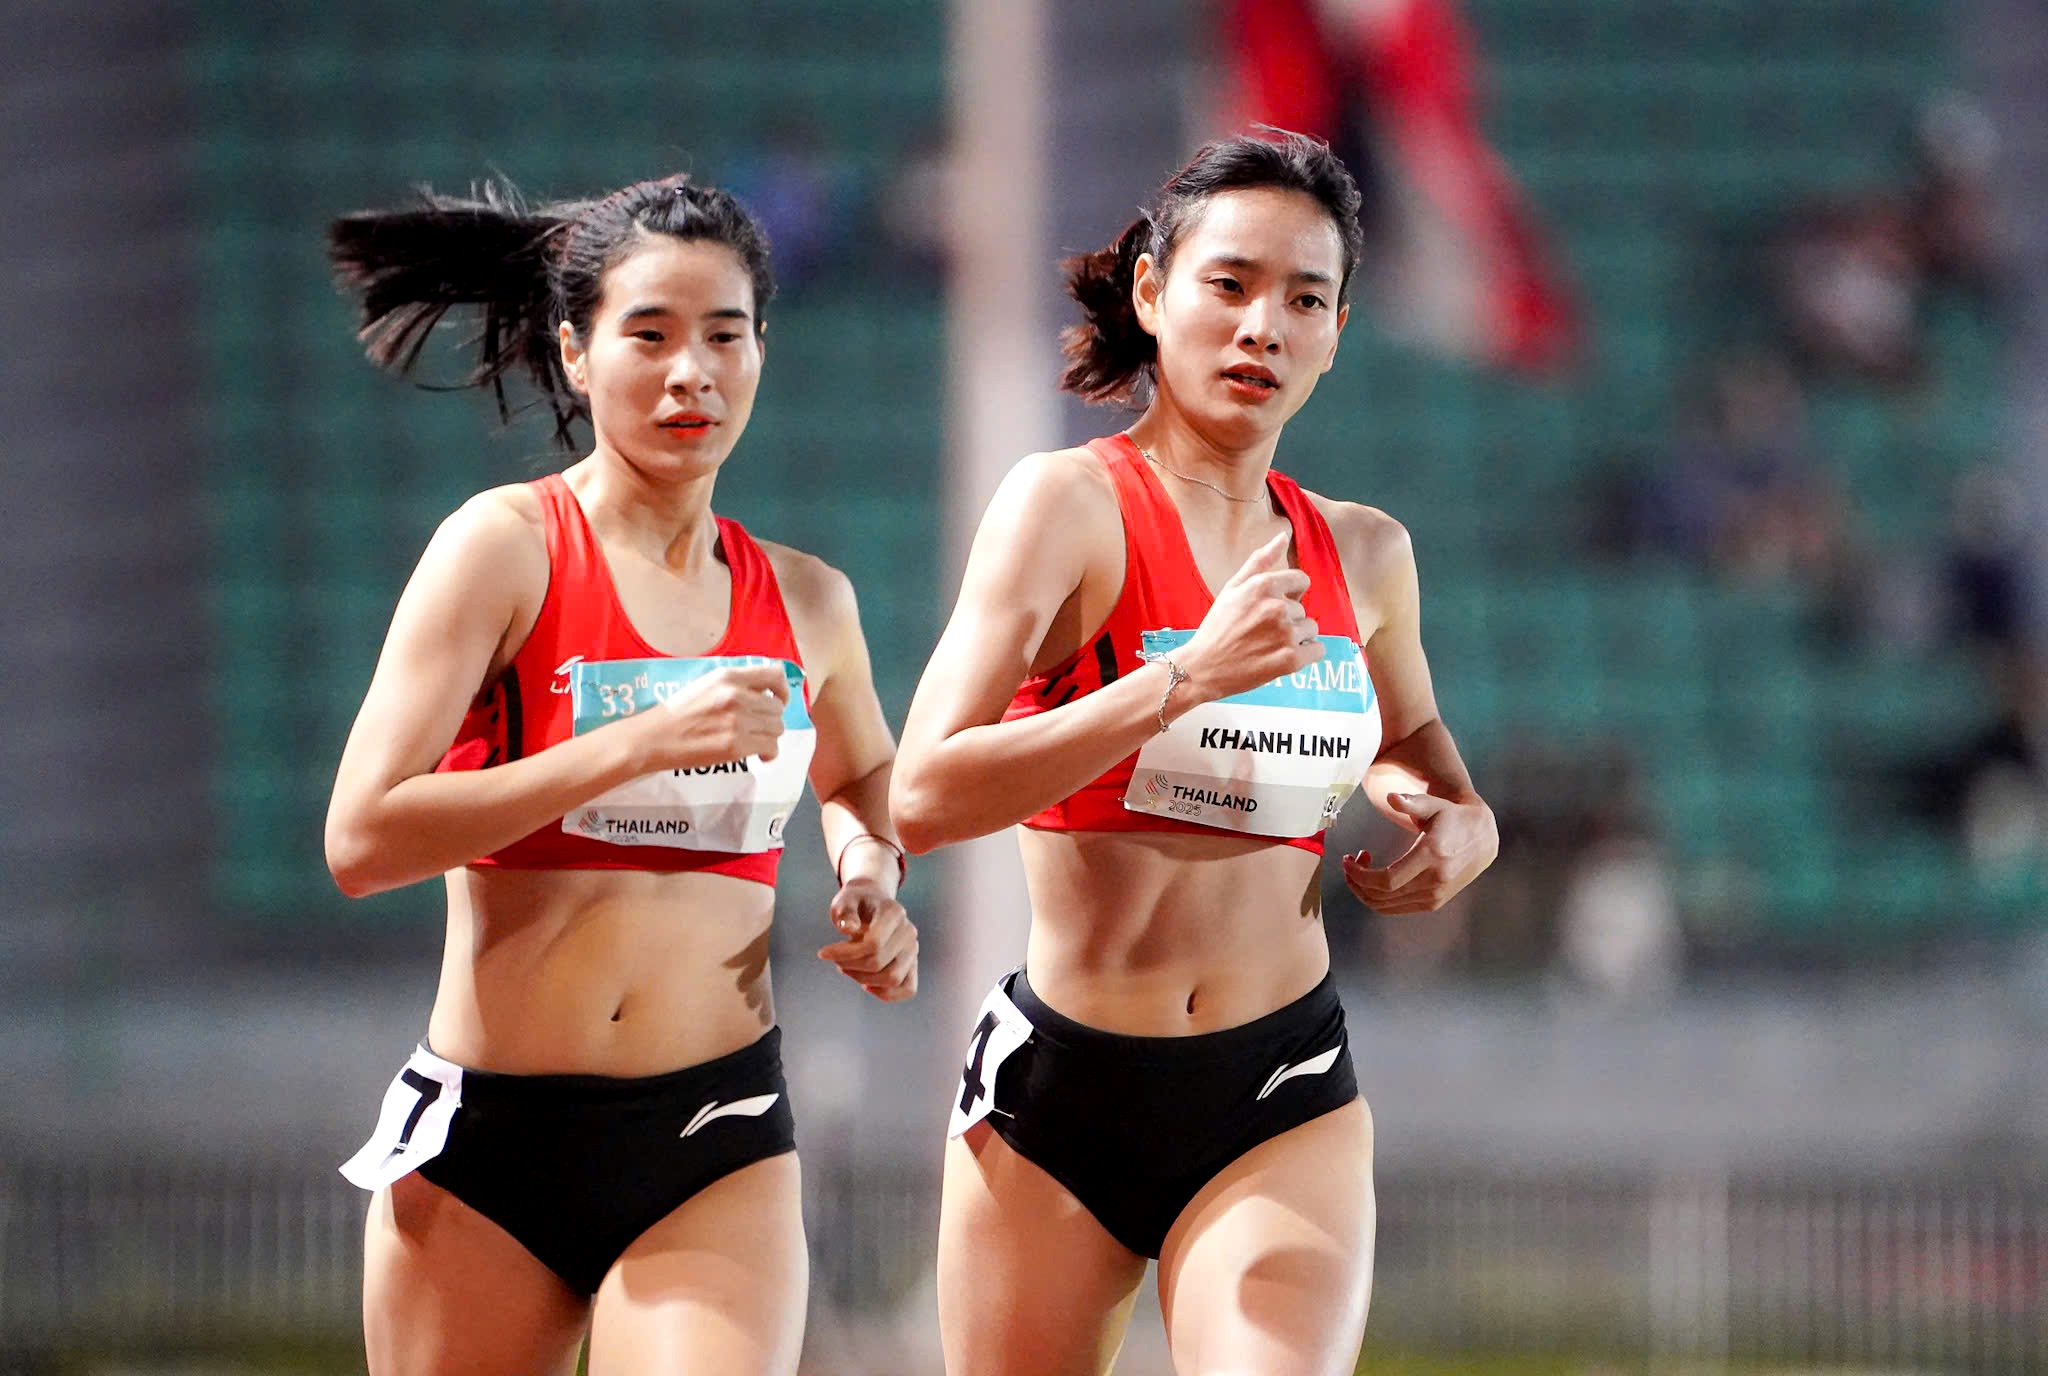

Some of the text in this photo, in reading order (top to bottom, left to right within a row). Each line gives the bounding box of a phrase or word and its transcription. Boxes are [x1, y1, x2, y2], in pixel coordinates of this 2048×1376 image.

[1290, 659, 1362, 693] GAME
[1200, 727, 1351, 759] KHANH LINH
[1168, 799, 1202, 817] 2025
[1172, 785, 1258, 813] THAILAND
[605, 818, 690, 835] THAILAND
[959, 1010, 1001, 1117] 4
[380, 1067, 443, 1169] 7
